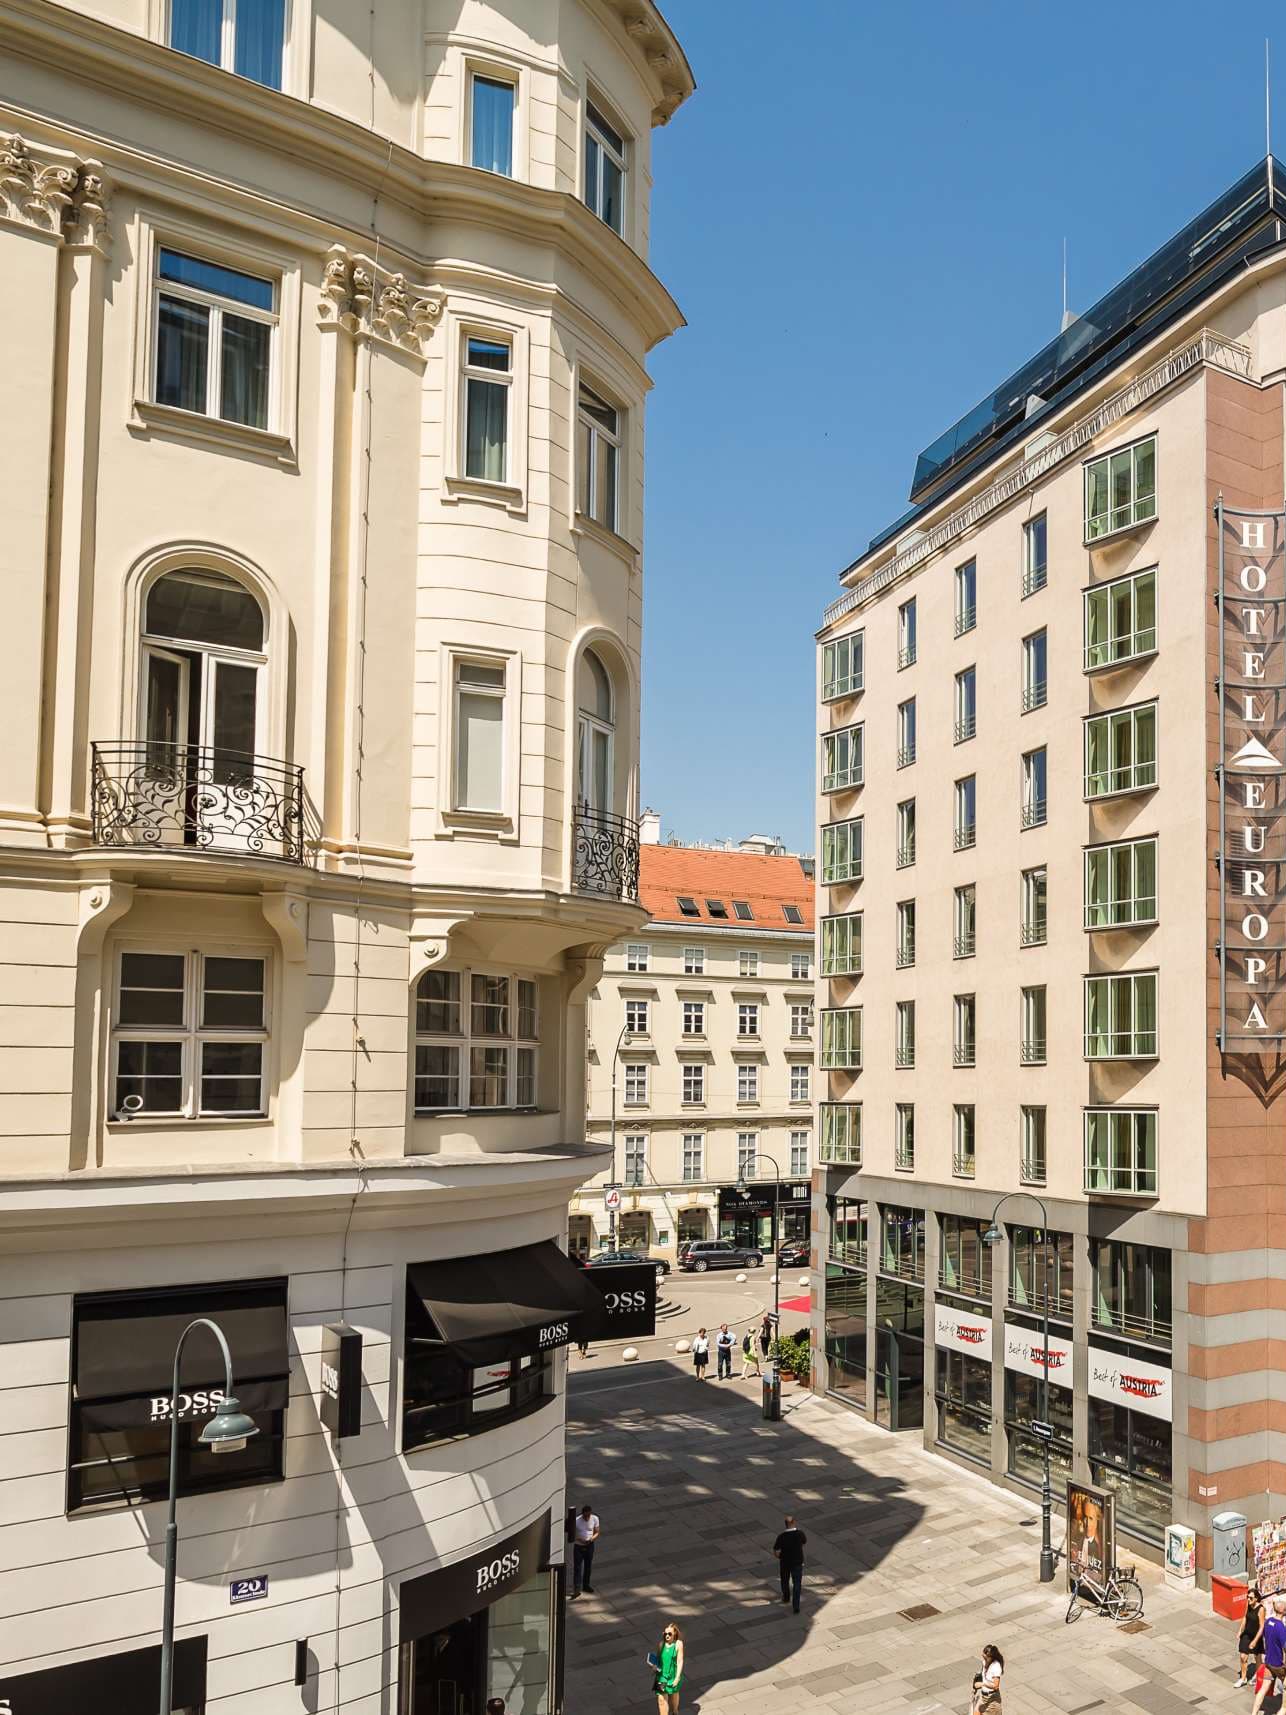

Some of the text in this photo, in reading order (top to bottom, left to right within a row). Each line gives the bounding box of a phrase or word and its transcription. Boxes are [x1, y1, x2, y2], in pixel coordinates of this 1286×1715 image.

[1240, 521, 1267, 722] HOTEL
[1241, 782, 1269, 1029] EUROPA
[604, 1290, 646, 1309] OSS
[539, 1322, 569, 1342] BOSS
[1030, 1347, 1065, 1368] AUSRIA
[1093, 1368, 1108, 1381] Best
[1120, 1374, 1162, 1397] AUSTRIA
[150, 1389, 225, 1416] BOSS
[476, 1549, 520, 1588] BOSS
[238, 1580, 261, 1594] 20
